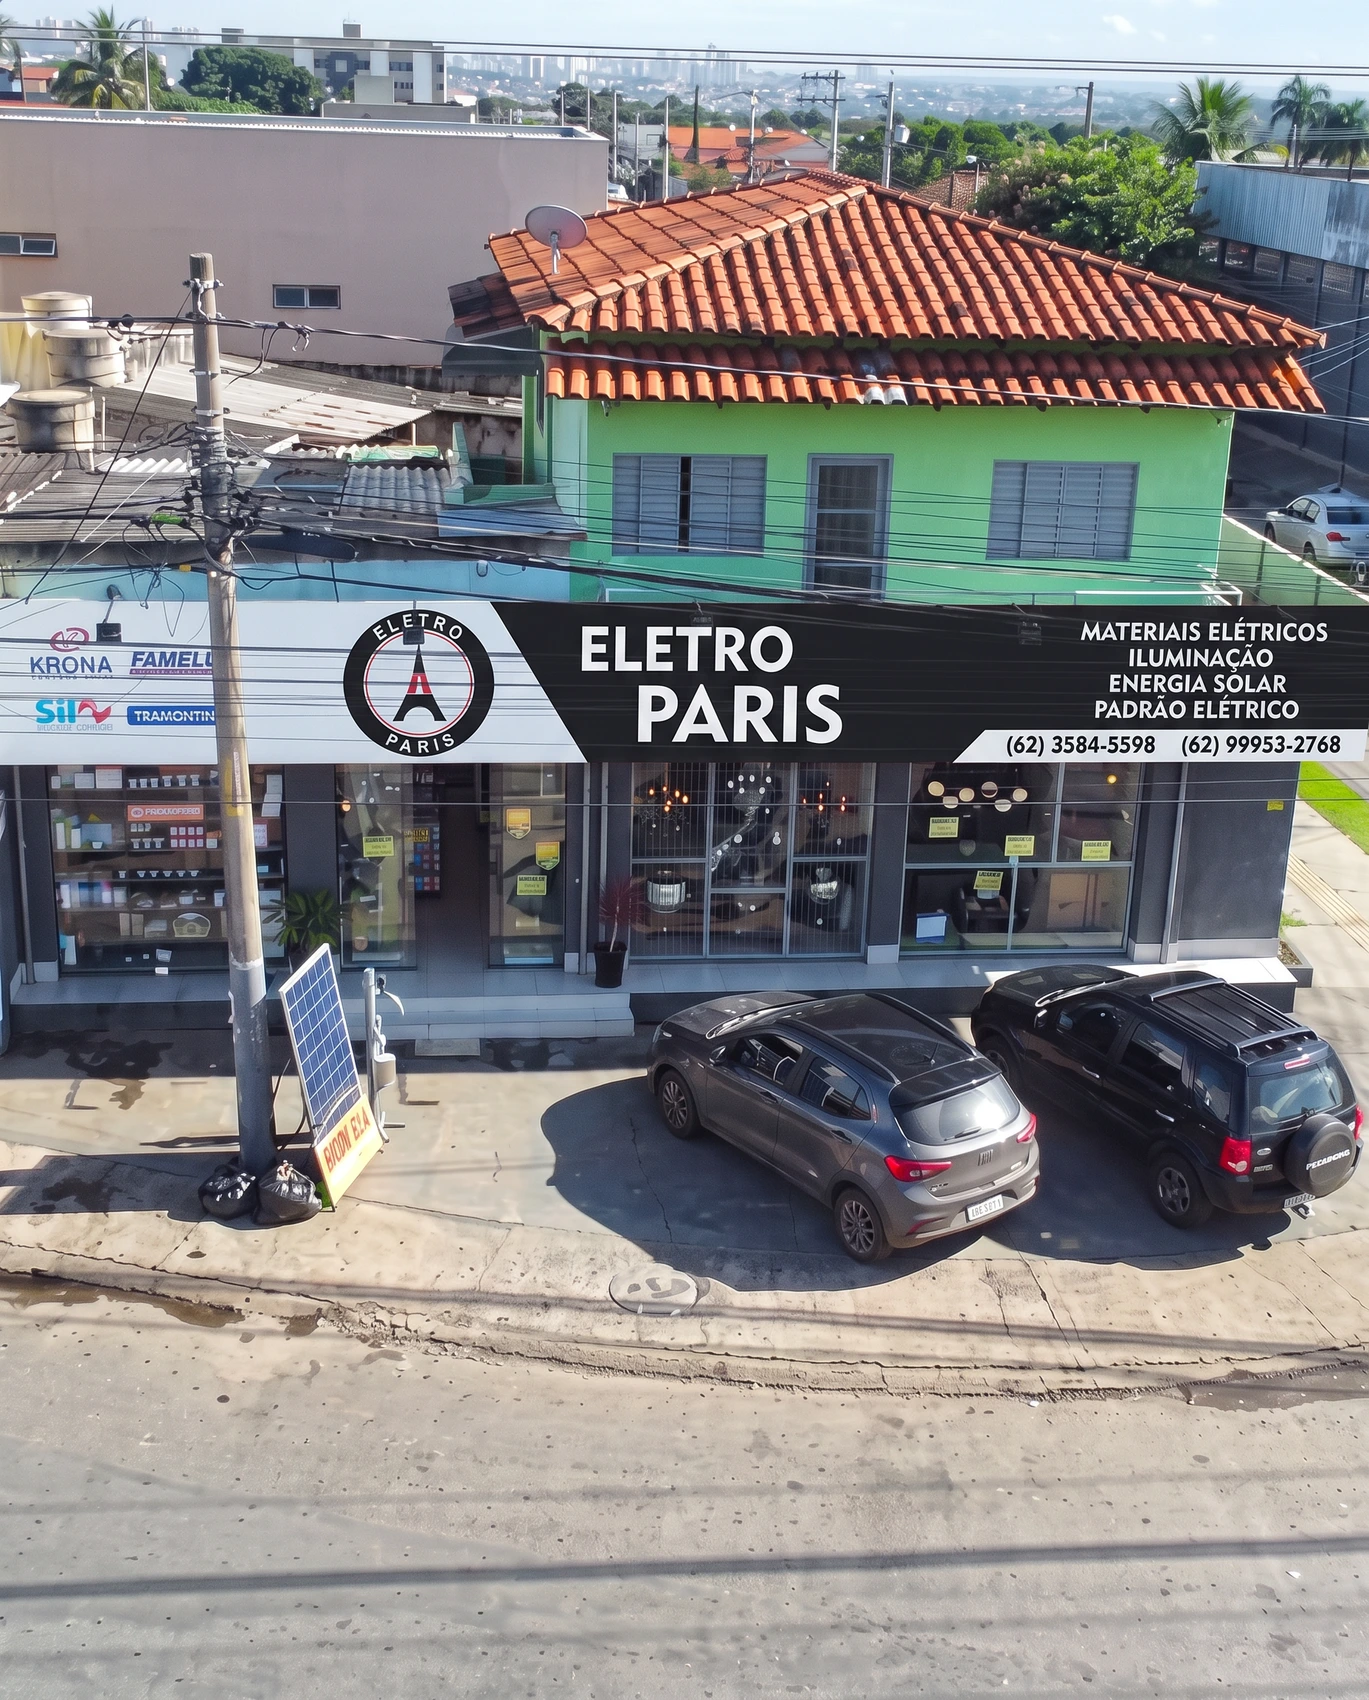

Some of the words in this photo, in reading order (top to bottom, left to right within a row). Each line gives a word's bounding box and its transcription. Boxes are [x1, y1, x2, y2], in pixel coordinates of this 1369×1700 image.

[372, 613, 463, 641] ELETRO
[1080, 621, 1201, 642] MATERIAIS
[1208, 617, 1328, 642] ELÉTRICOS
[581, 625, 794, 673] ELETRO
[1129, 644, 1274, 673] ILUMINAÇÃO
[30, 656, 113, 674] KRONA
[1109, 673, 1207, 693] ENERGIA
[1213, 673, 1287, 693] SOLAR
[35, 697, 77, 724] Sil
[637, 683, 843, 745] PARIS
[1094, 695, 1187, 719] PADRÃO
[1193, 694, 1300, 719] ELÉTRICO
[385, 733, 455, 754] PARIS
[1006, 734, 1045, 758] (62)
[1051, 734, 1156, 754] 3584-5598
[1181, 734, 1220, 758] (62)
[1225, 734, 1341, 754] 99953-2768
